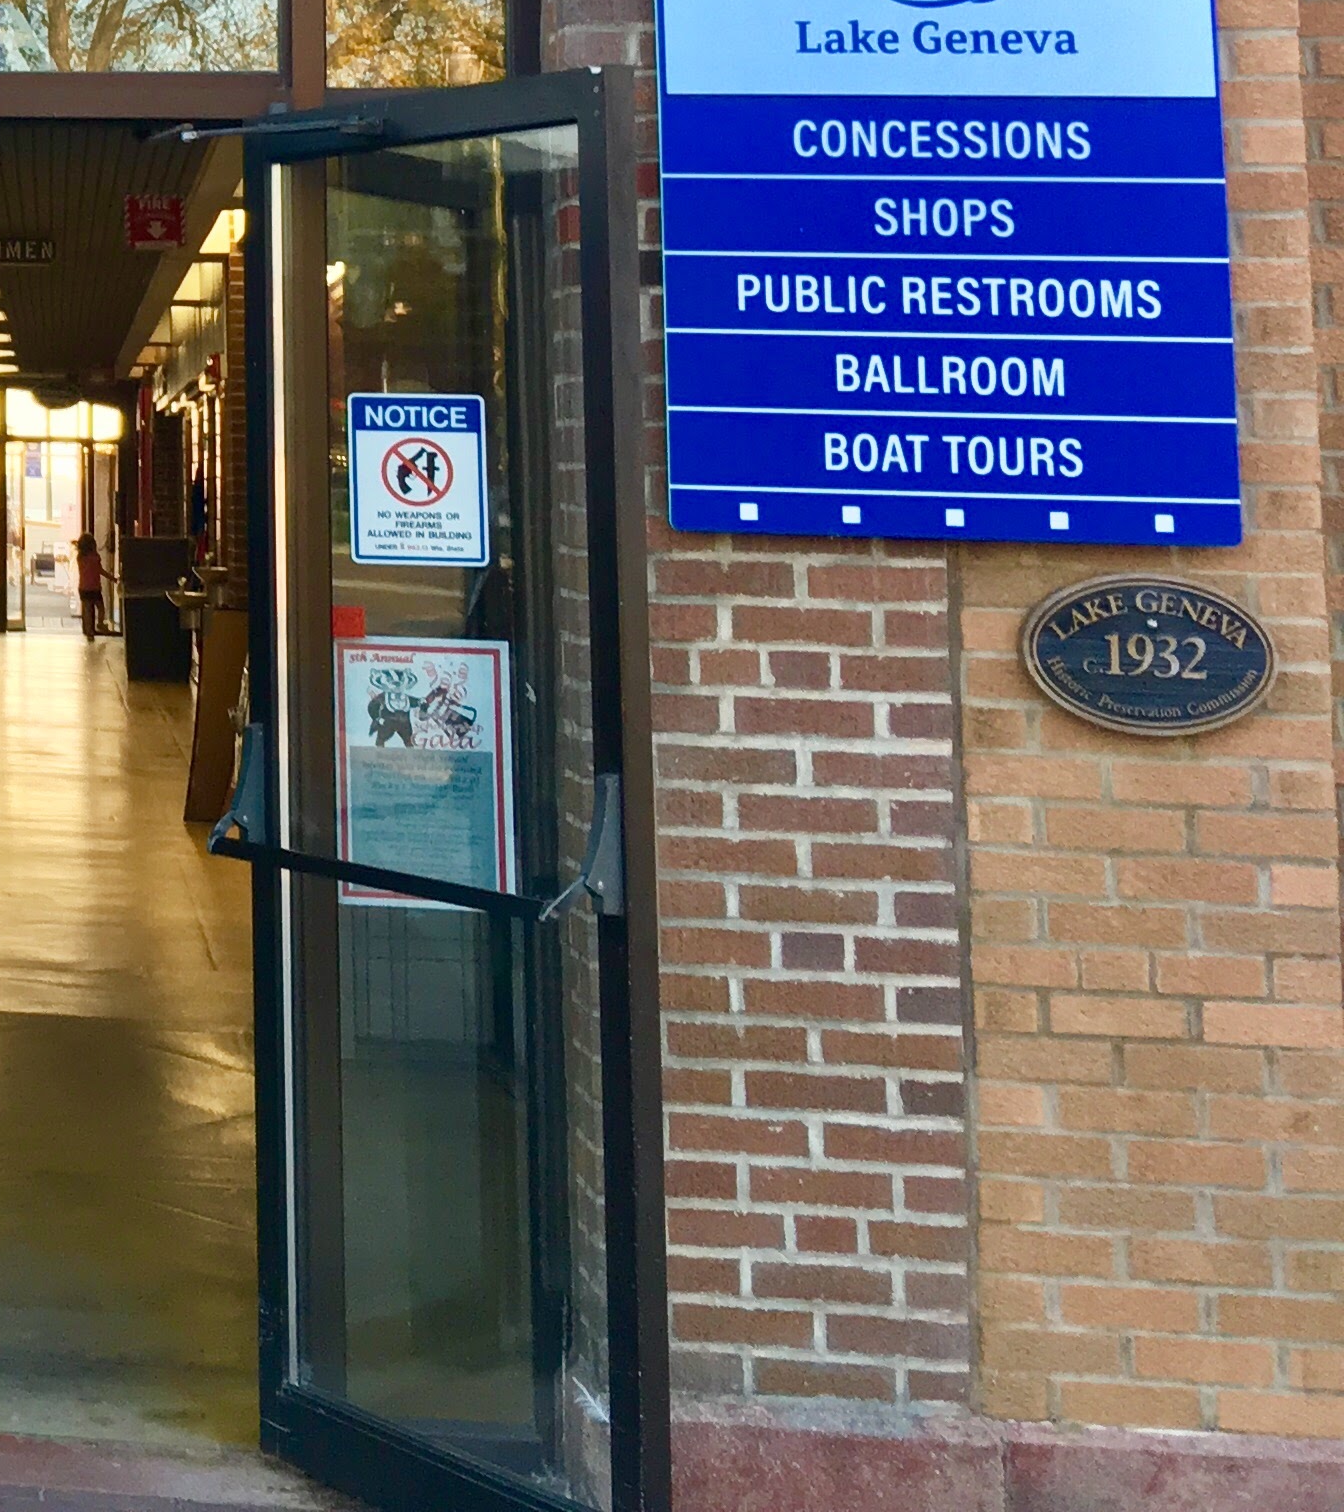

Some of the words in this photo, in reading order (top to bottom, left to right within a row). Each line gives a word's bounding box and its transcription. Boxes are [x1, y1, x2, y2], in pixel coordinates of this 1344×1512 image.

[795, 20, 899, 55] Lake
[913, 21, 1078, 56] Geneva
[793, 120, 1092, 160] CONCESSIONS
[874, 198, 1015, 238] SHOPS
[737, 274, 886, 315] PUBLIC
[903, 277, 1162, 320] RESTROOMS
[835, 354, 1066, 397] BALLROOM
[365, 405, 467, 429] NOTICE
[824, 432, 926, 474] BOAT
[943, 436, 1083, 479] TOURS
[377, 510, 391, 519] NO
[395, 510, 442, 520] WEAPONS
[446, 512, 460, 520] OR
[395, 521, 443, 530] FIREARMS
[367, 529, 412, 538] ALLOWED
[416, 530, 424, 538] IN
[428, 531, 472, 540] BUILDING
[1048, 593, 1128, 640] LAKE
[1135, 590, 1248, 650] GENEVA
[370, 652, 416, 664] Annual
[1047, 655, 1093, 701] Historic
[1098, 695, 1182, 719] Preservation
[1187, 669, 1258, 716] Commission
[411, 732, 482, 749] Gala
